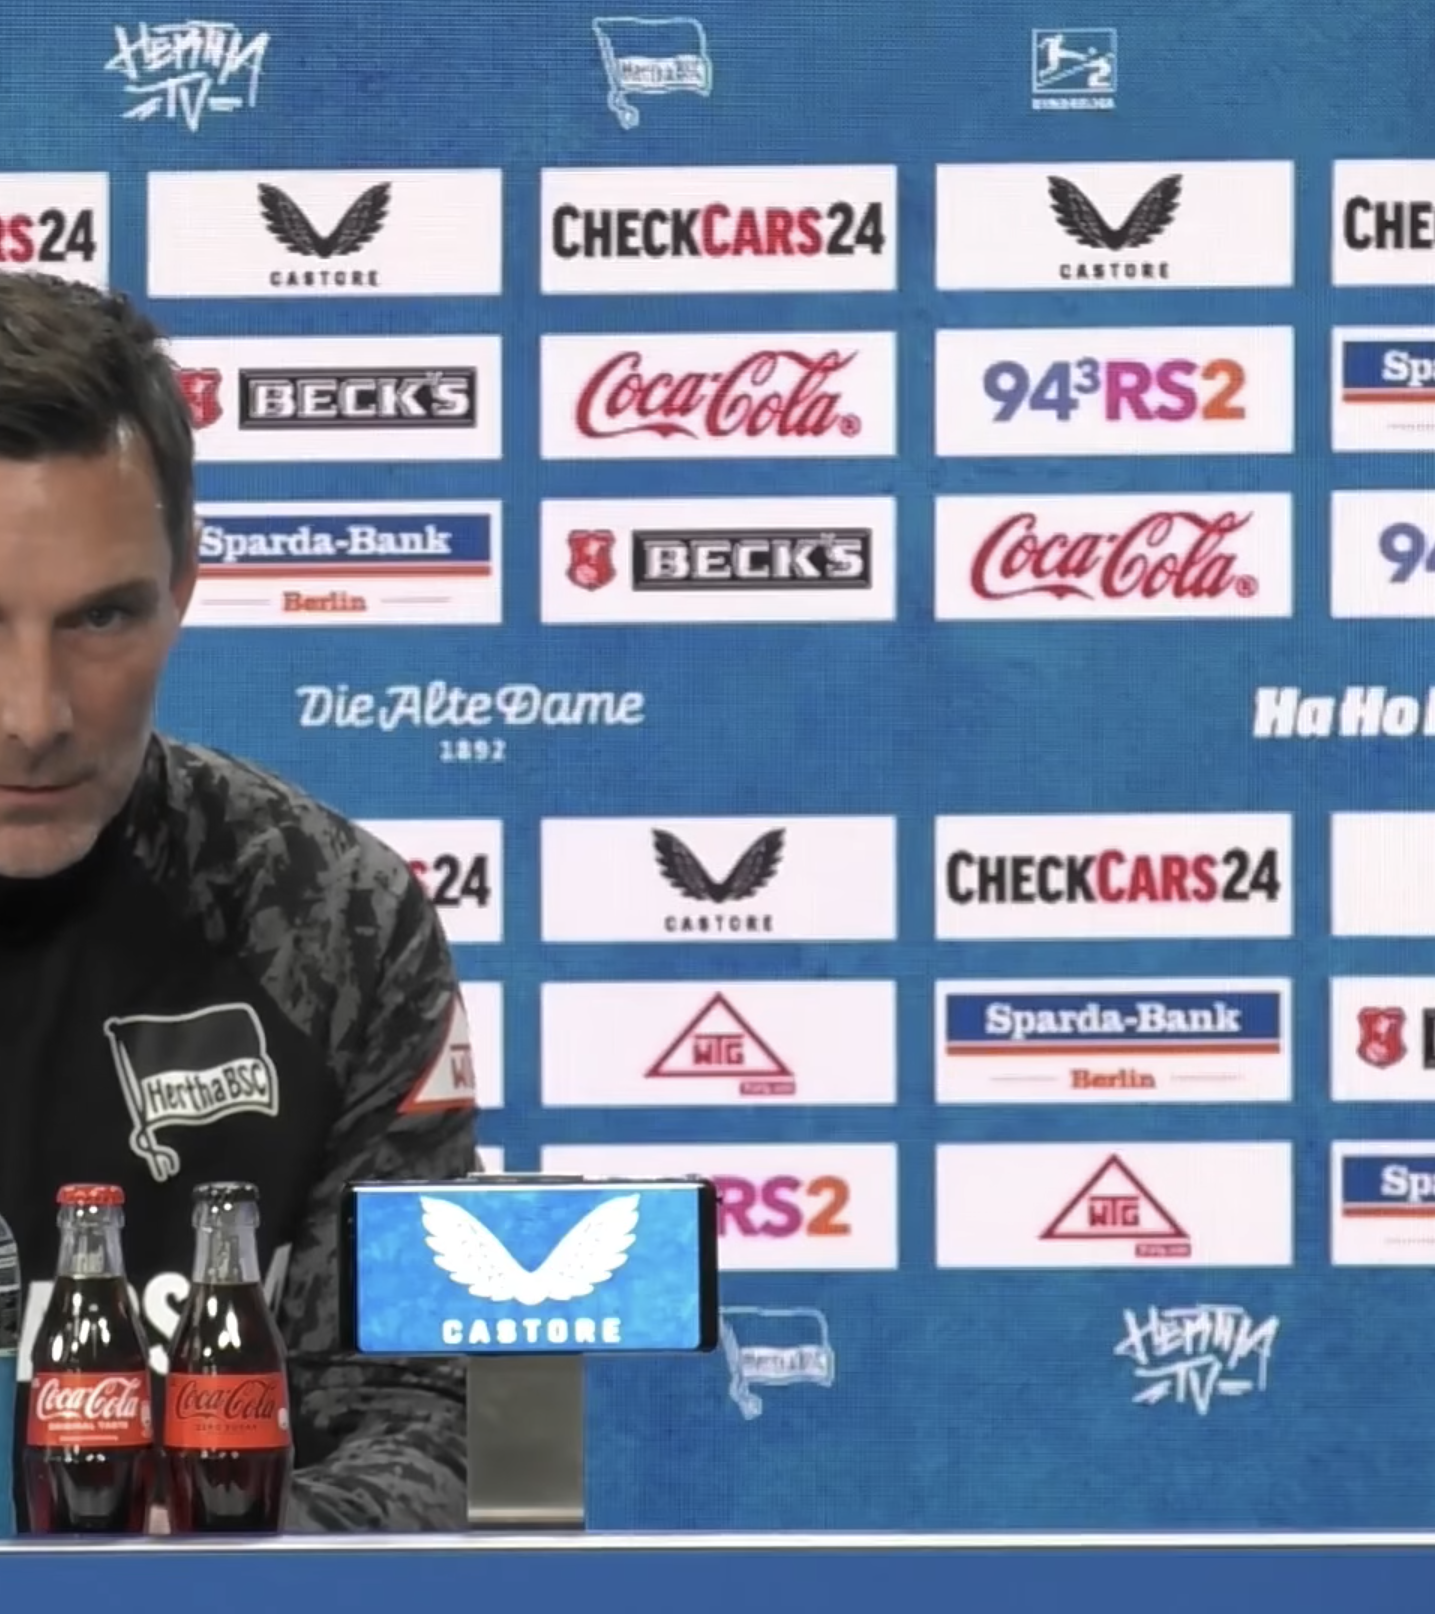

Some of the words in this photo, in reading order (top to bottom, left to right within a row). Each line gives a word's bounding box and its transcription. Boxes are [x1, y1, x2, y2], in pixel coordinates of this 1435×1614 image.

[552, 201, 886, 259] CHECKCARS24
[270, 270, 379, 287] CASTORE
[1059, 262, 1170, 280] CASTORE
[249, 372, 470, 419] BECK'S
[199, 524, 452, 561] Sparda-Bank
[644, 531, 865, 579] BECK'S
[282, 590, 368, 613] Berlin
[439, 740, 507, 762] 1892
[946, 848, 1281, 905] CHECKCARS24
[664, 915, 773, 932] CASTORE
[986, 1003, 1241, 1041] Sparda-Bank
[693, 1034, 745, 1065] WTG
[1070, 1068, 1157, 1089] Berlin
[1088, 1195, 1140, 1227] WTG
[441, 1317, 622, 1345] CASTORE
[36, 1377, 142, 1420] Coca-Cola
[174, 1380, 277, 1420] Coca-Cola
